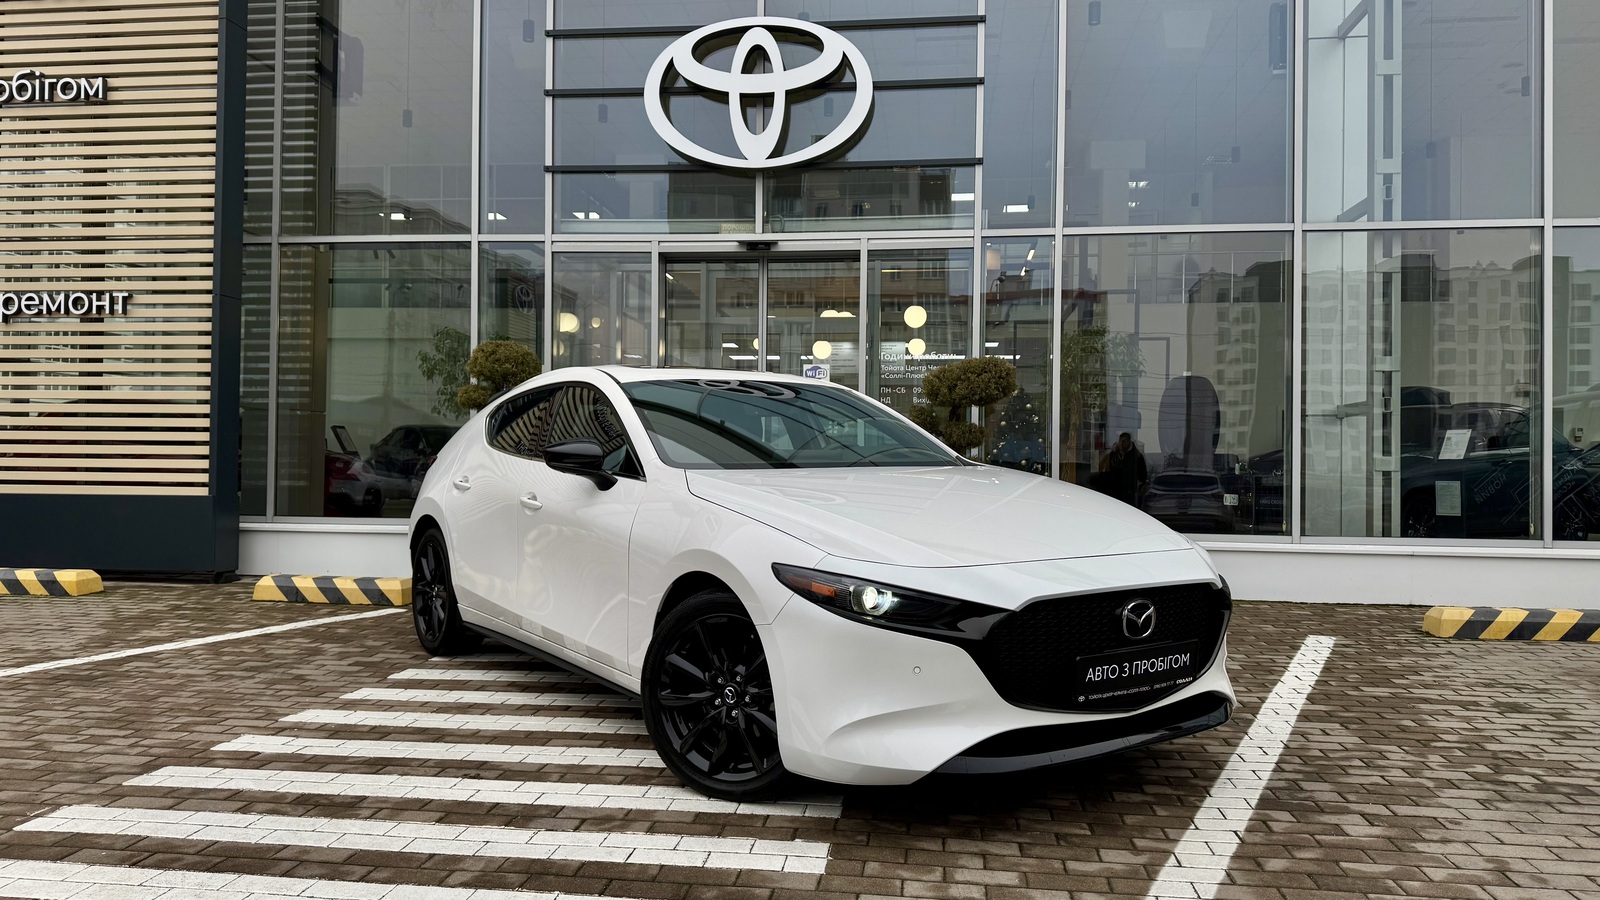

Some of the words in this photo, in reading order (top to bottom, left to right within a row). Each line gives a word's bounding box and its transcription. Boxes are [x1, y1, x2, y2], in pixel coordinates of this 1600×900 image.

[0, 292, 129, 323] ремонт
[881, 352, 917, 361] Годи
[905, 364, 927, 372] Центр
[880, 386, 892, 394] ПН
[880, 396, 892, 404] НД
[1085, 664, 1119, 682] АВТО
[1132, 652, 1190, 676] ПРОБІГОМ
